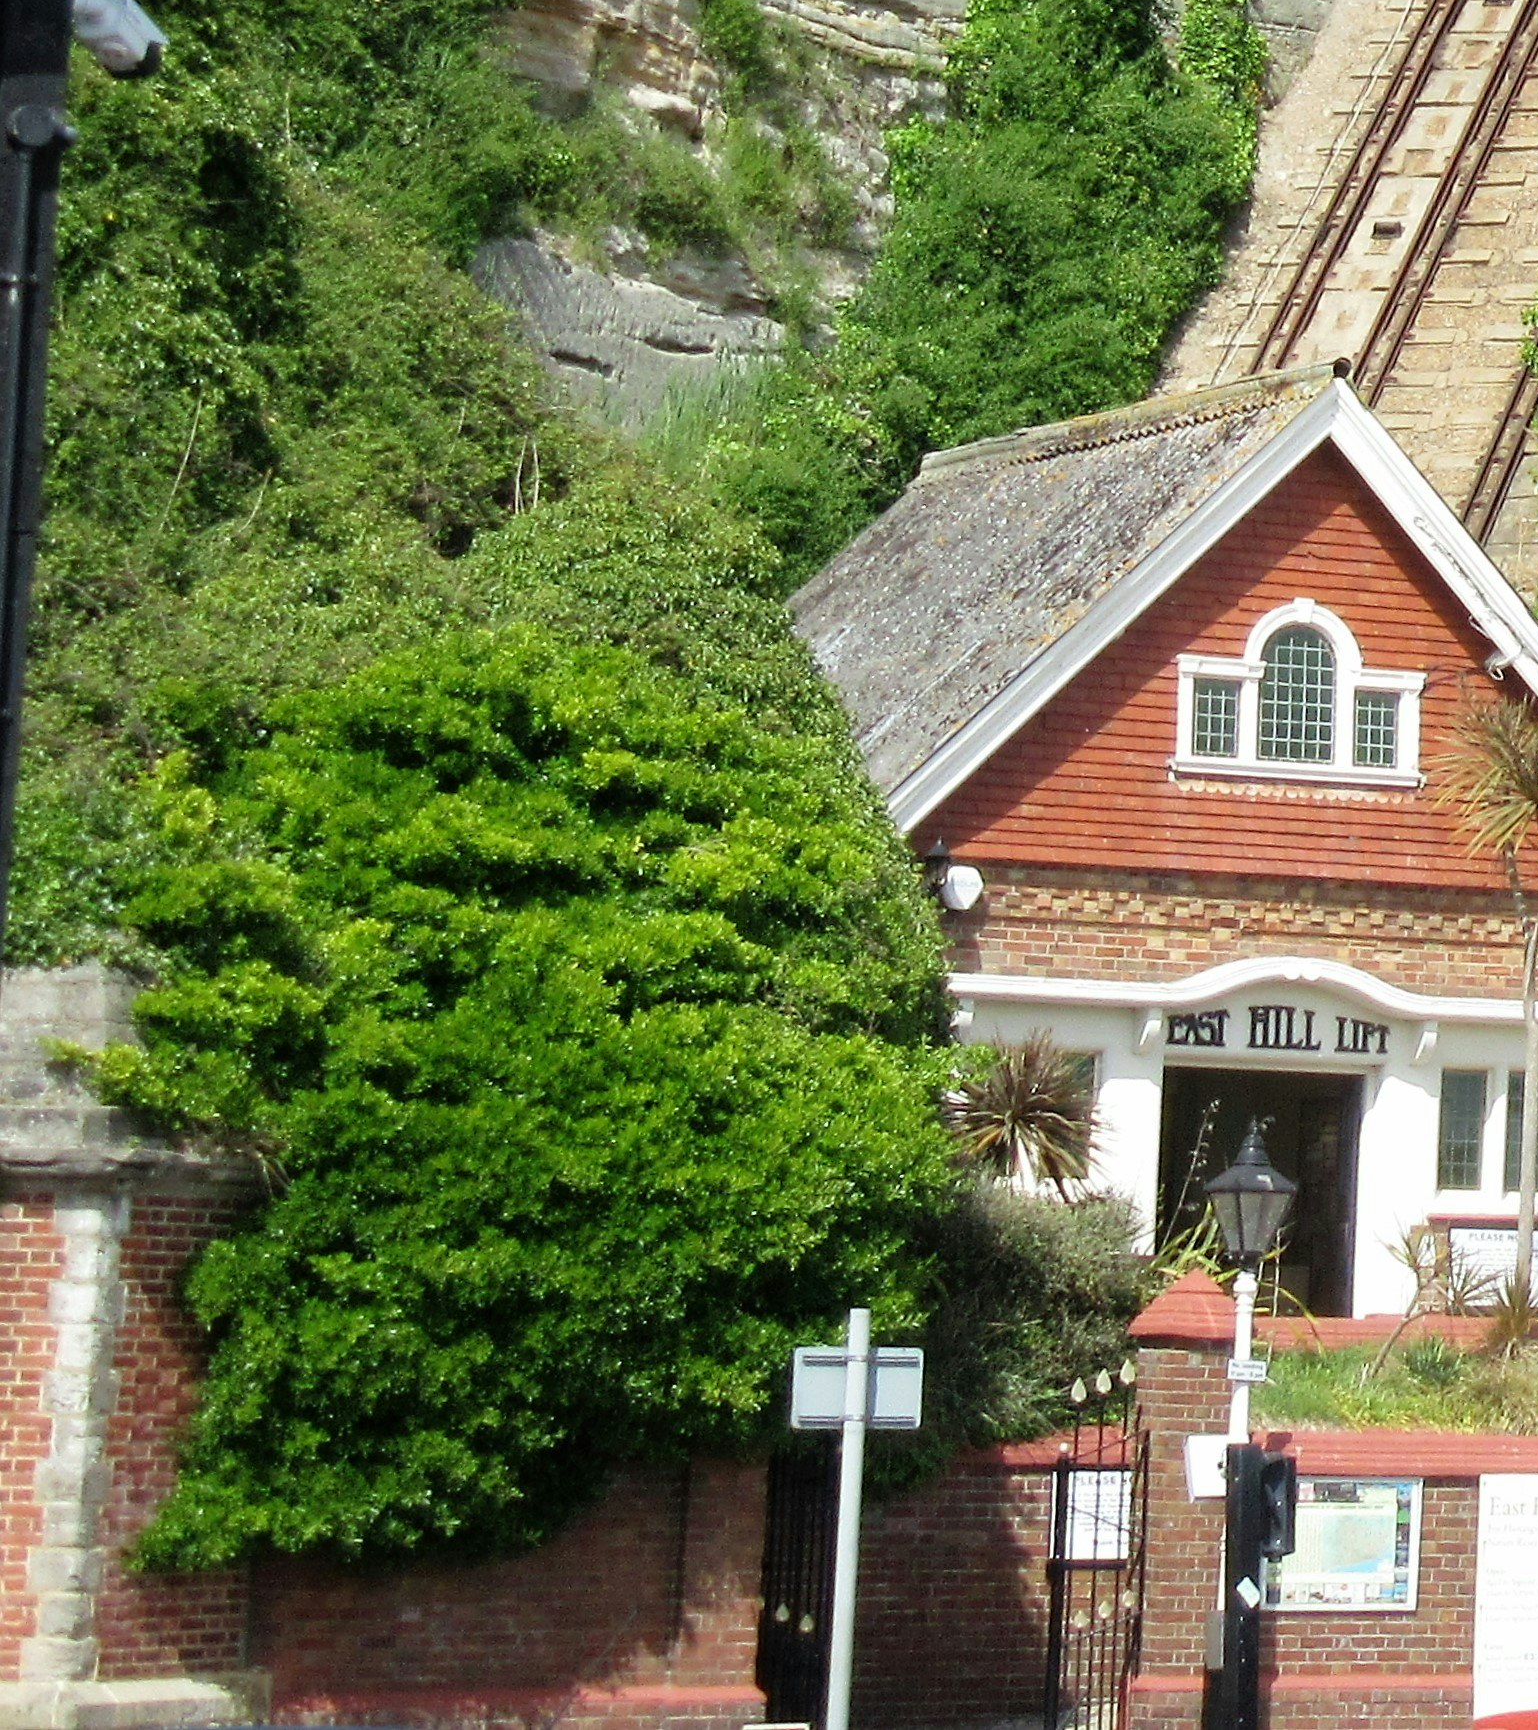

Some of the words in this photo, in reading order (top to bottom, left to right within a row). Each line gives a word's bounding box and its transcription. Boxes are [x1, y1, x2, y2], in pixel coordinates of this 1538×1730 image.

[1166, 1009, 1231, 1046] EAST
[1248, 1005, 1322, 1051] HILL
[1334, 1016, 1391, 1054] LIFT
[1468, 1232, 1504, 1242] PLEASE
[1075, 1475, 1116, 1485] PLESE
[1489, 1496, 1526, 1517] East
